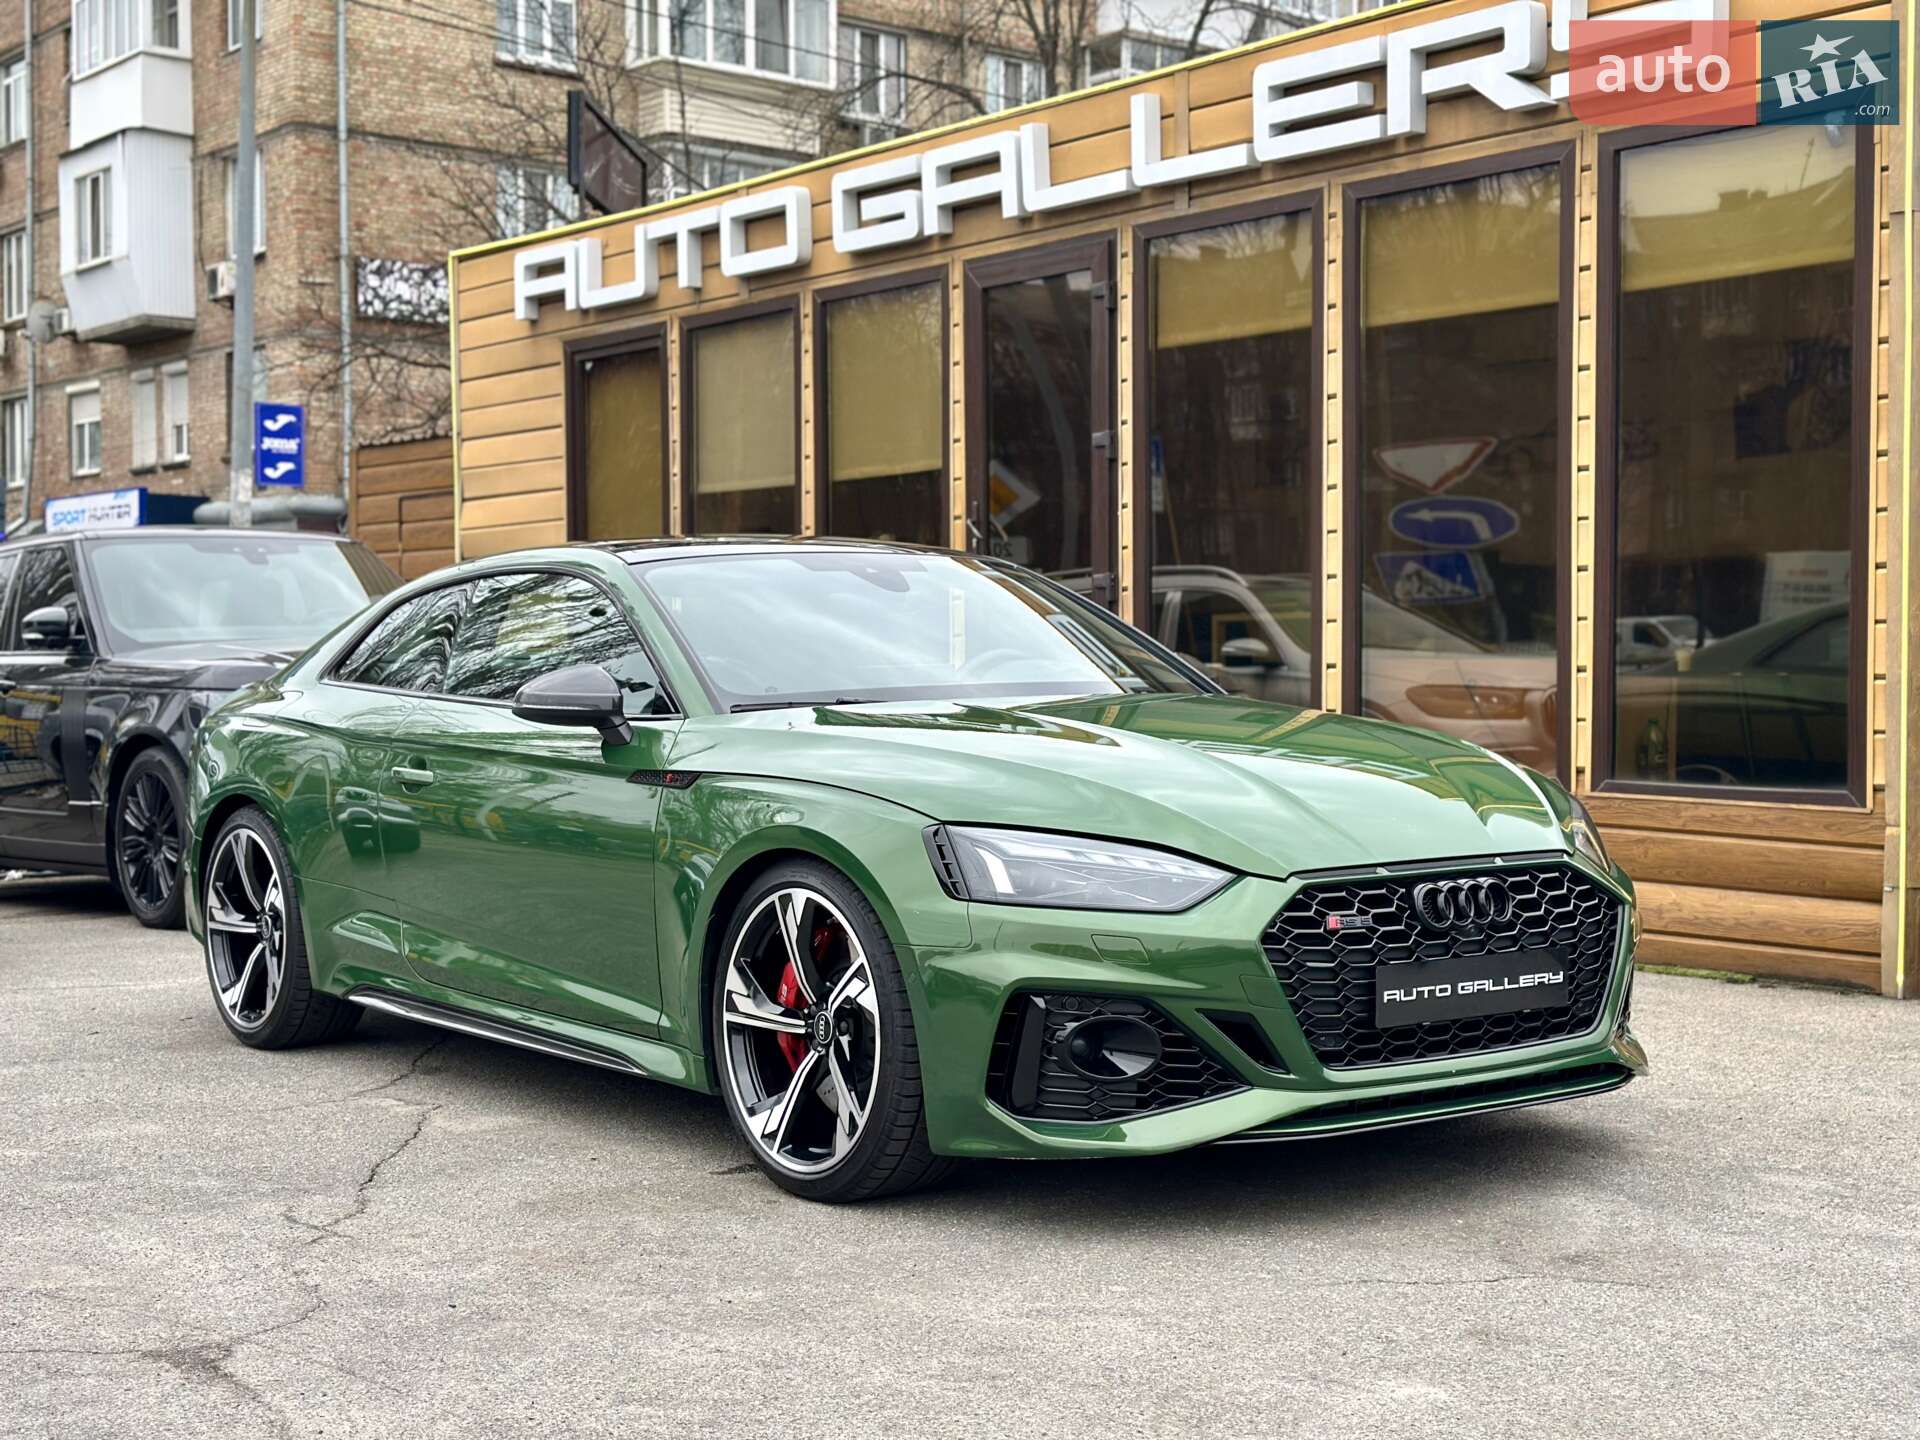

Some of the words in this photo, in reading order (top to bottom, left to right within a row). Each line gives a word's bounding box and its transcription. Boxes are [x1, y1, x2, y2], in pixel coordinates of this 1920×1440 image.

[513, 185, 812, 320] AUTO
[52, 509, 87, 526] SPORT
[1383, 984, 1452, 1004] AUTO
[1457, 971, 1564, 995] GALLERY
